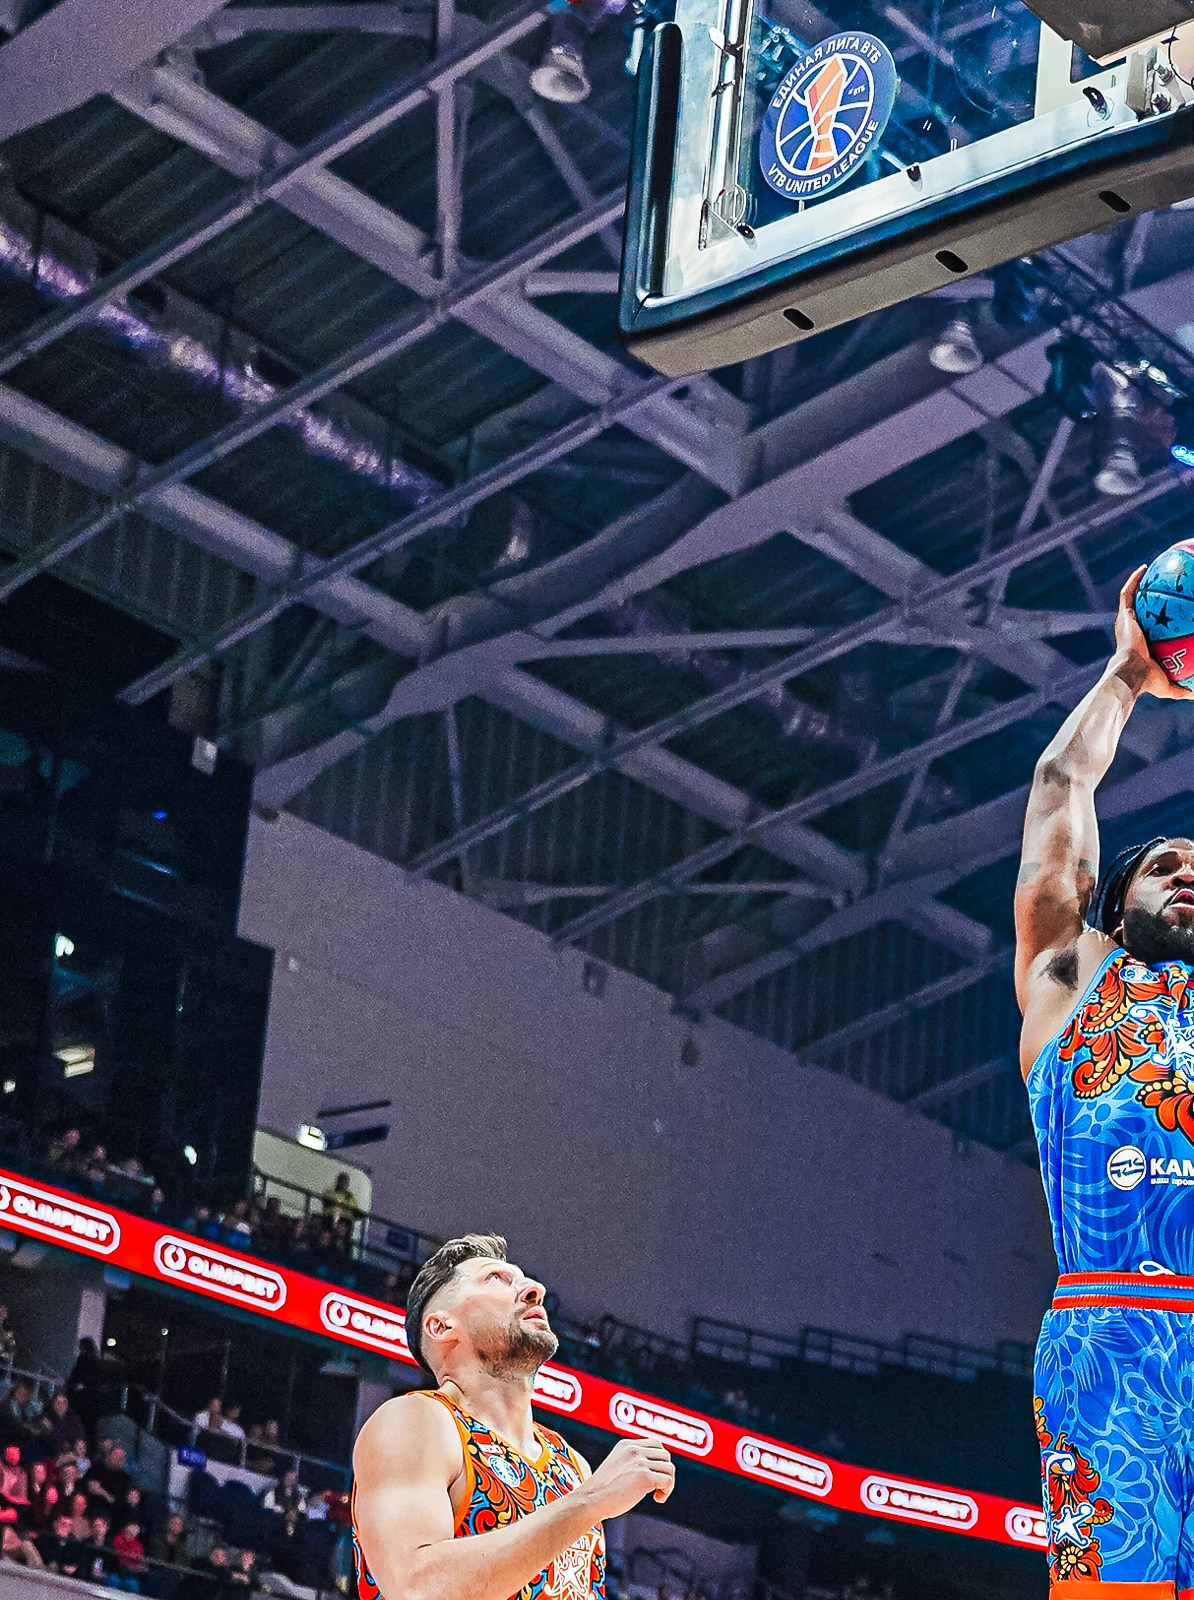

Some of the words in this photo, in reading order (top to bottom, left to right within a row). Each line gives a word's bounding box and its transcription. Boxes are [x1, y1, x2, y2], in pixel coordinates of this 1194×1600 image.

[772, 46, 823, 109] ЕДИНАЯ
[826, 36, 860, 54] ЛИГА
[861, 41, 882, 64] ВТБ
[767, 162, 787, 187] VTB
[785, 173, 831, 194] UNITED
[834, 119, 879, 180] LEAGUE
[13, 1195, 111, 1242] OLIMPBET
[187, 1255, 279, 1300] OLIMPBET
